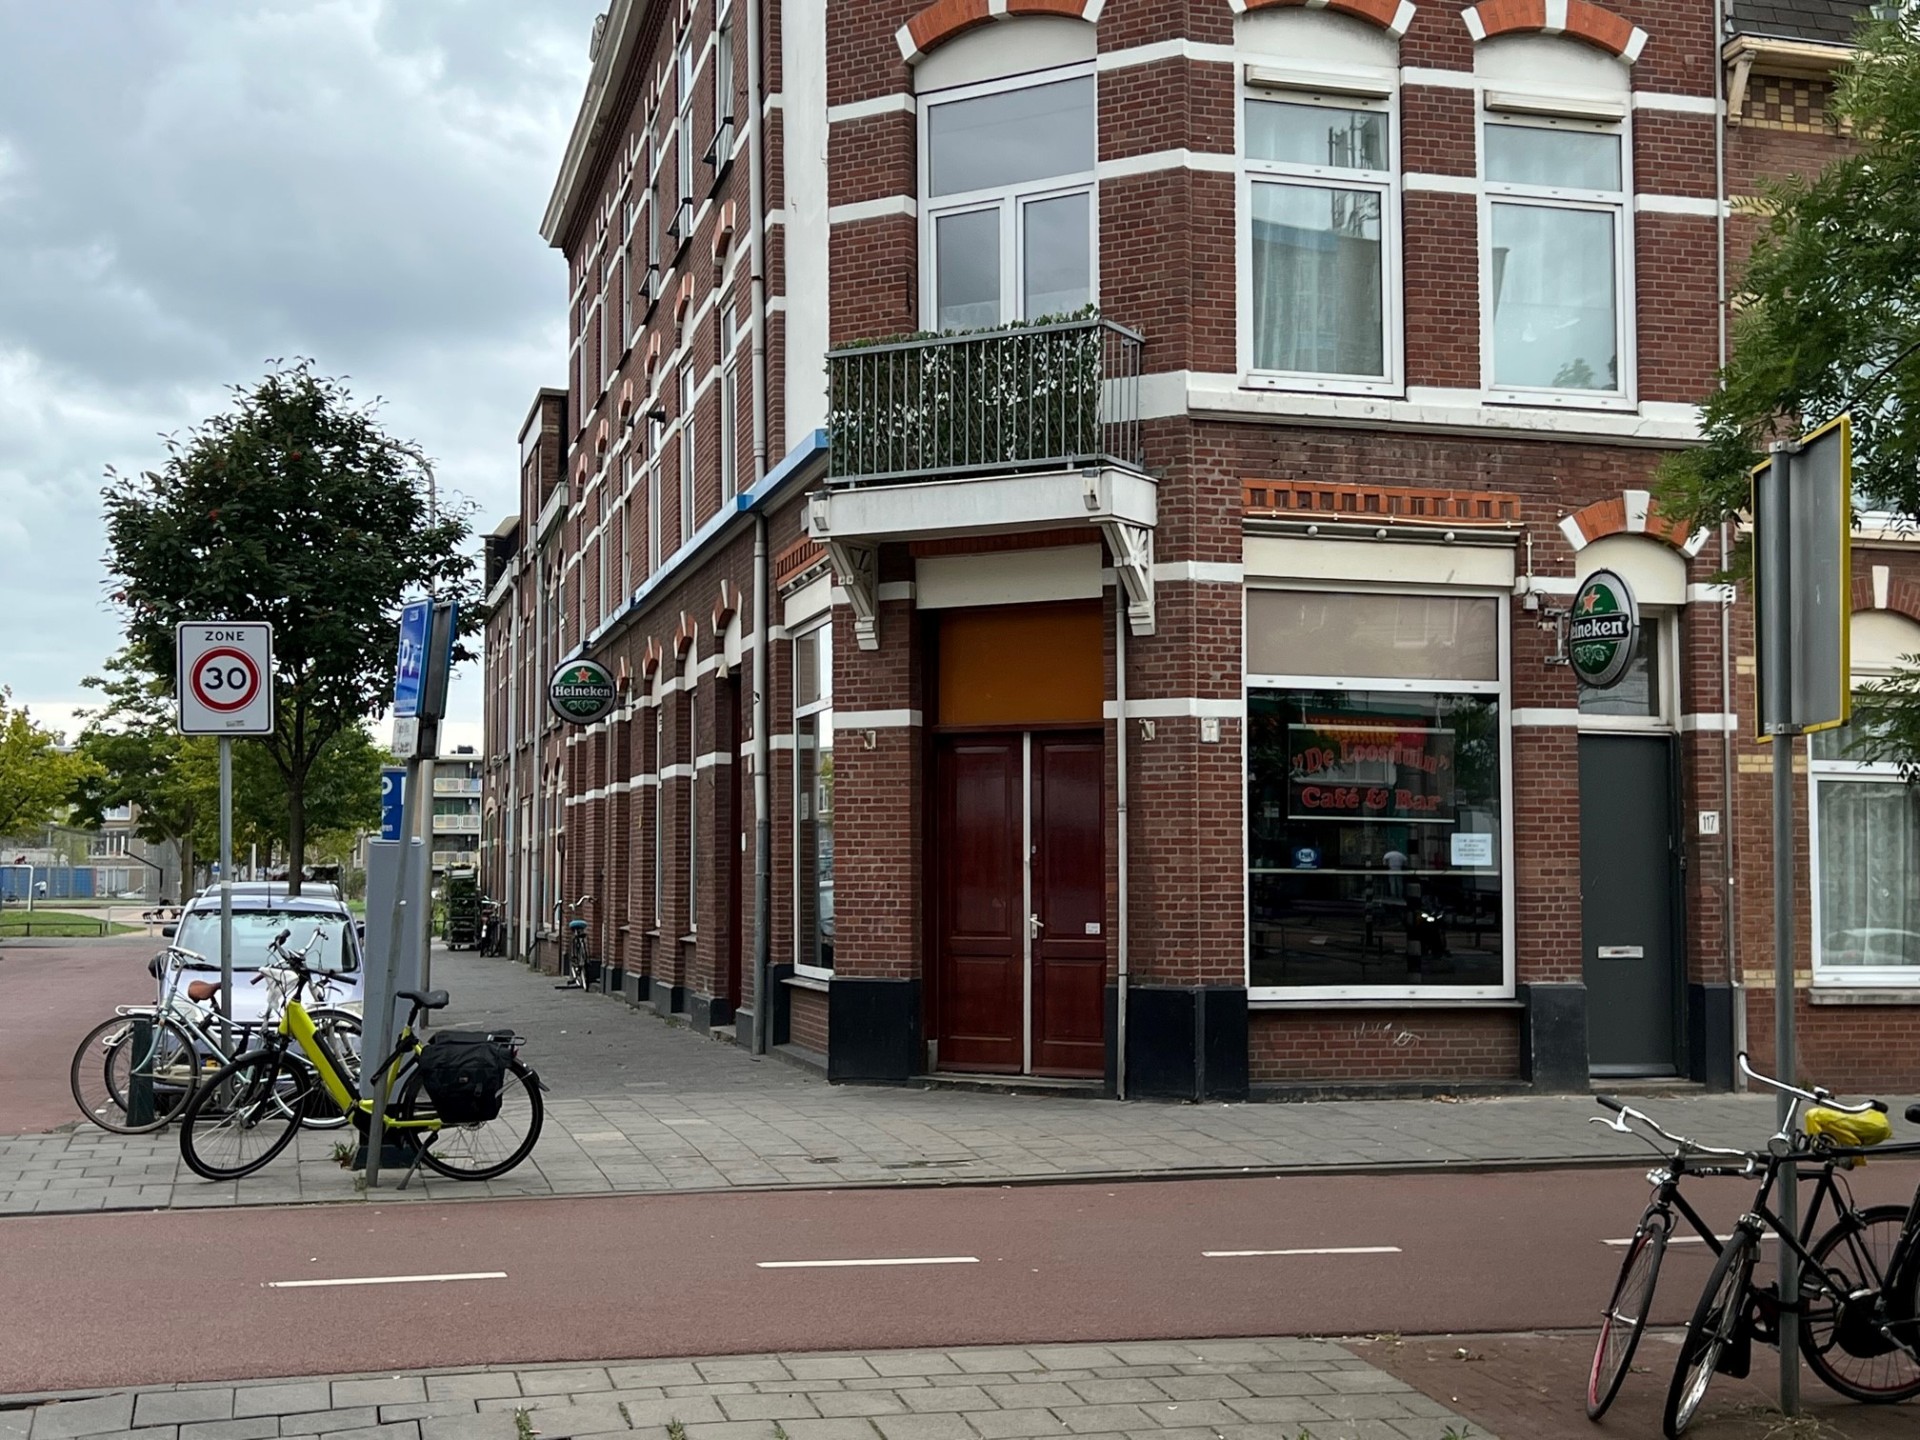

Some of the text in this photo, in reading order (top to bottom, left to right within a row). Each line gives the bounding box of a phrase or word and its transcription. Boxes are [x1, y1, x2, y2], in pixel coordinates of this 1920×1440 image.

[205, 631, 245, 641] ZONE
[1571, 618, 1624, 638] eineken
[204, 667, 247, 690] 30
[555, 686, 610, 697] Heineken
[1301, 786, 1441, 811] Café & Bar
[1702, 814, 1716, 831] 117
